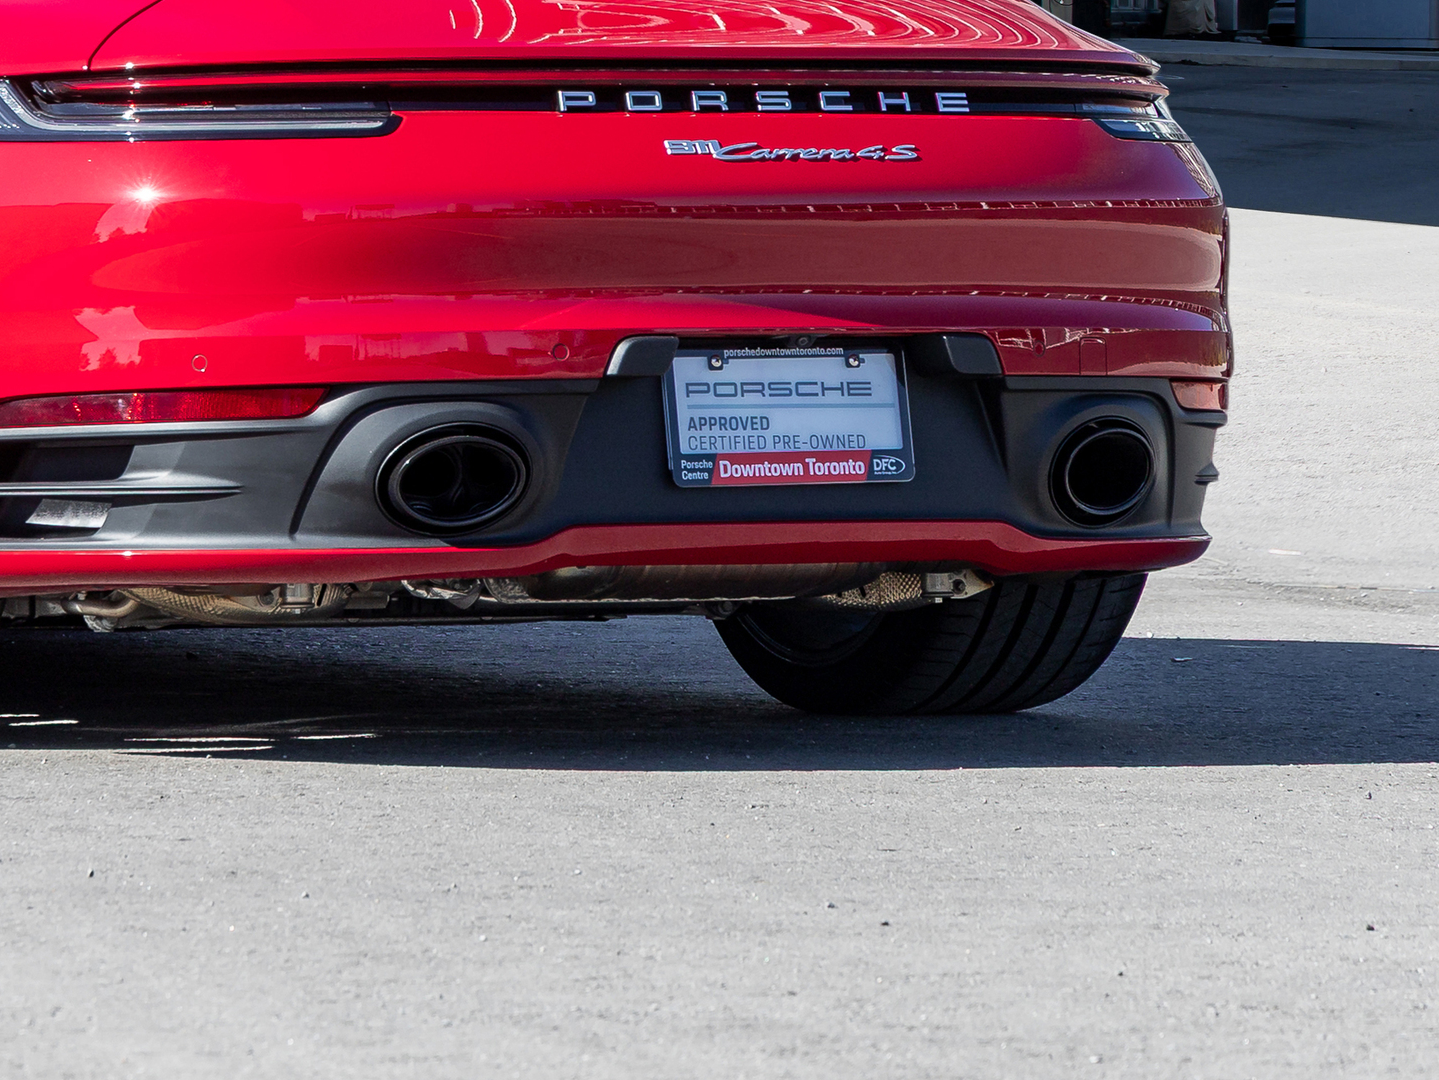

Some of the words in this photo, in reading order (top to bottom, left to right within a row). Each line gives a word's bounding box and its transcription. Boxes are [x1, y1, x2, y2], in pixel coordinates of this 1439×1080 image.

[557, 90, 970, 112] PORSCHE
[663, 139, 720, 156] 911
[712, 142, 856, 162] Carrera
[723, 346, 844, 358] porschedowntowntoronto.com
[685, 381, 872, 398] PORSCHE
[688, 415, 770, 431] APPROVED
[688, 435, 767, 451] CERTIFIED
[773, 434, 866, 450] PRE-OWNED
[681, 460, 713, 470] Porsche
[719, 461, 804, 478] Downtown
[805, 458, 865, 475] Toronto
[873, 458, 897, 471] DFC
[681, 471, 709, 480] Centre
